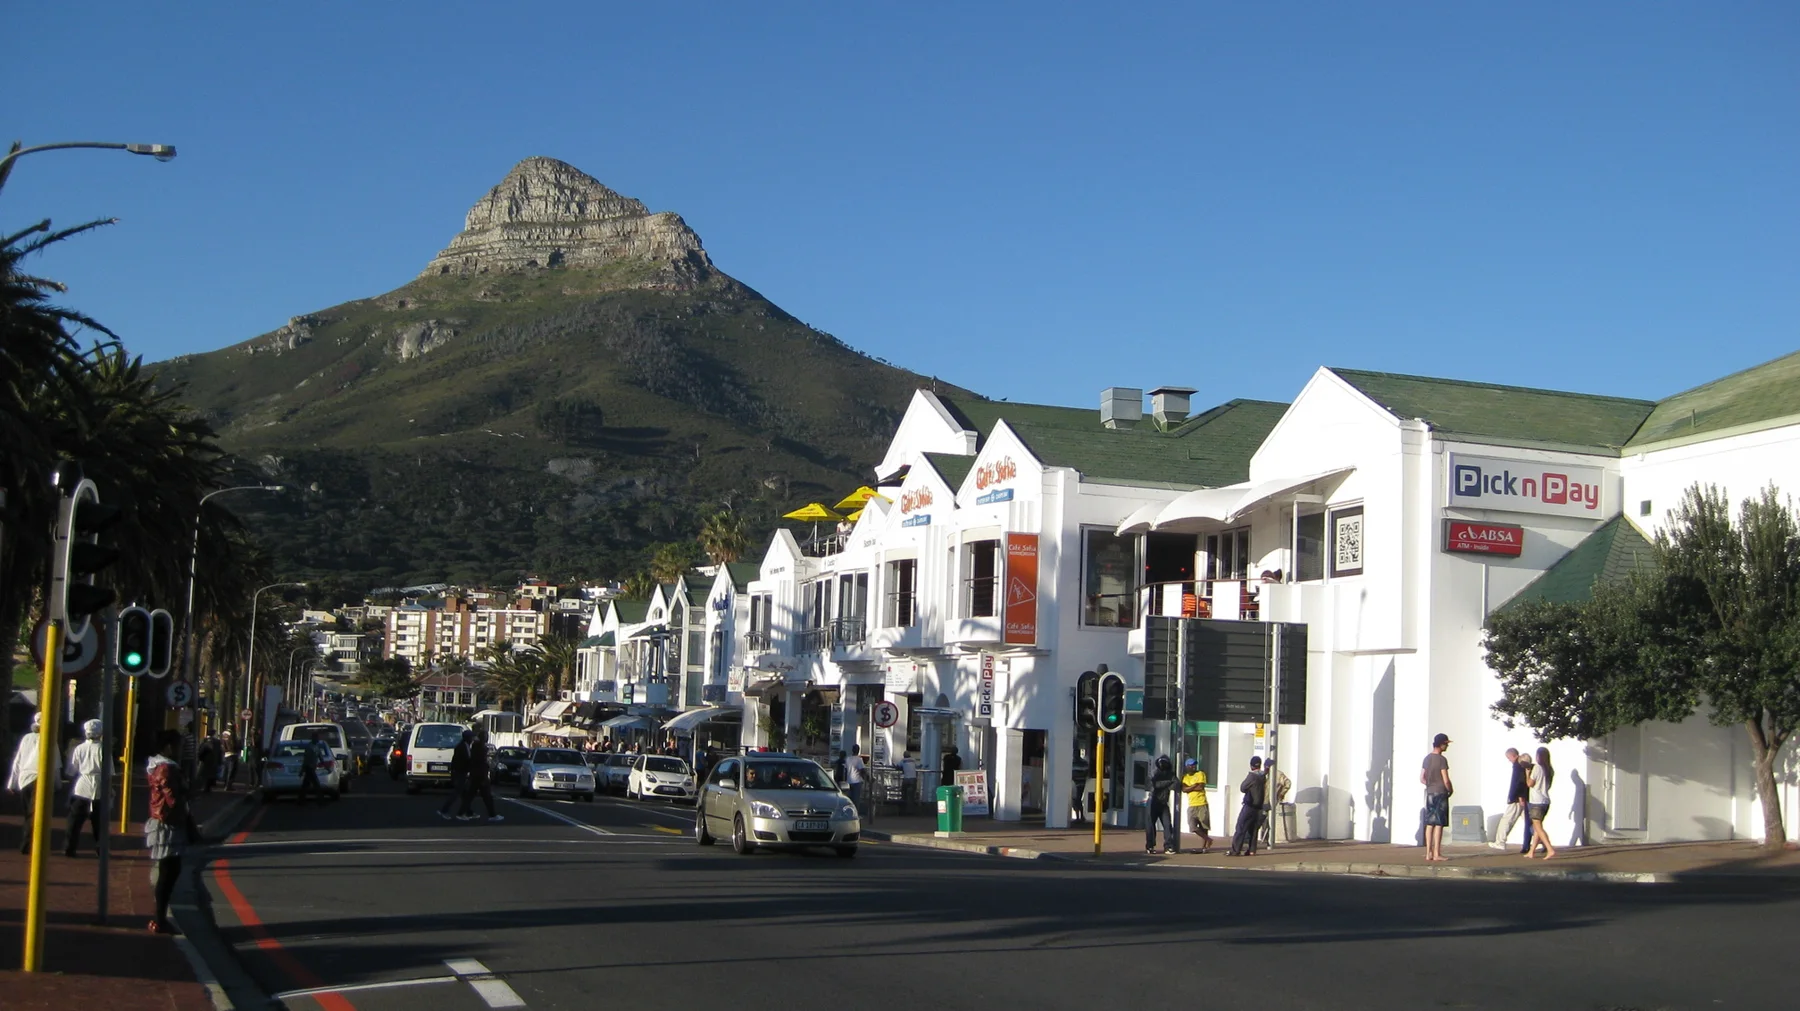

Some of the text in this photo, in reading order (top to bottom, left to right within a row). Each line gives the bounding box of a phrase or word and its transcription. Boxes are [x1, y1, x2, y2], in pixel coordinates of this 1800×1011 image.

[1455, 465, 1599, 510] Pick n Pay
[1478, 530, 1514, 542] ABSA
[982, 655, 994, 680] Pay
[980, 689, 992, 715] Pick
